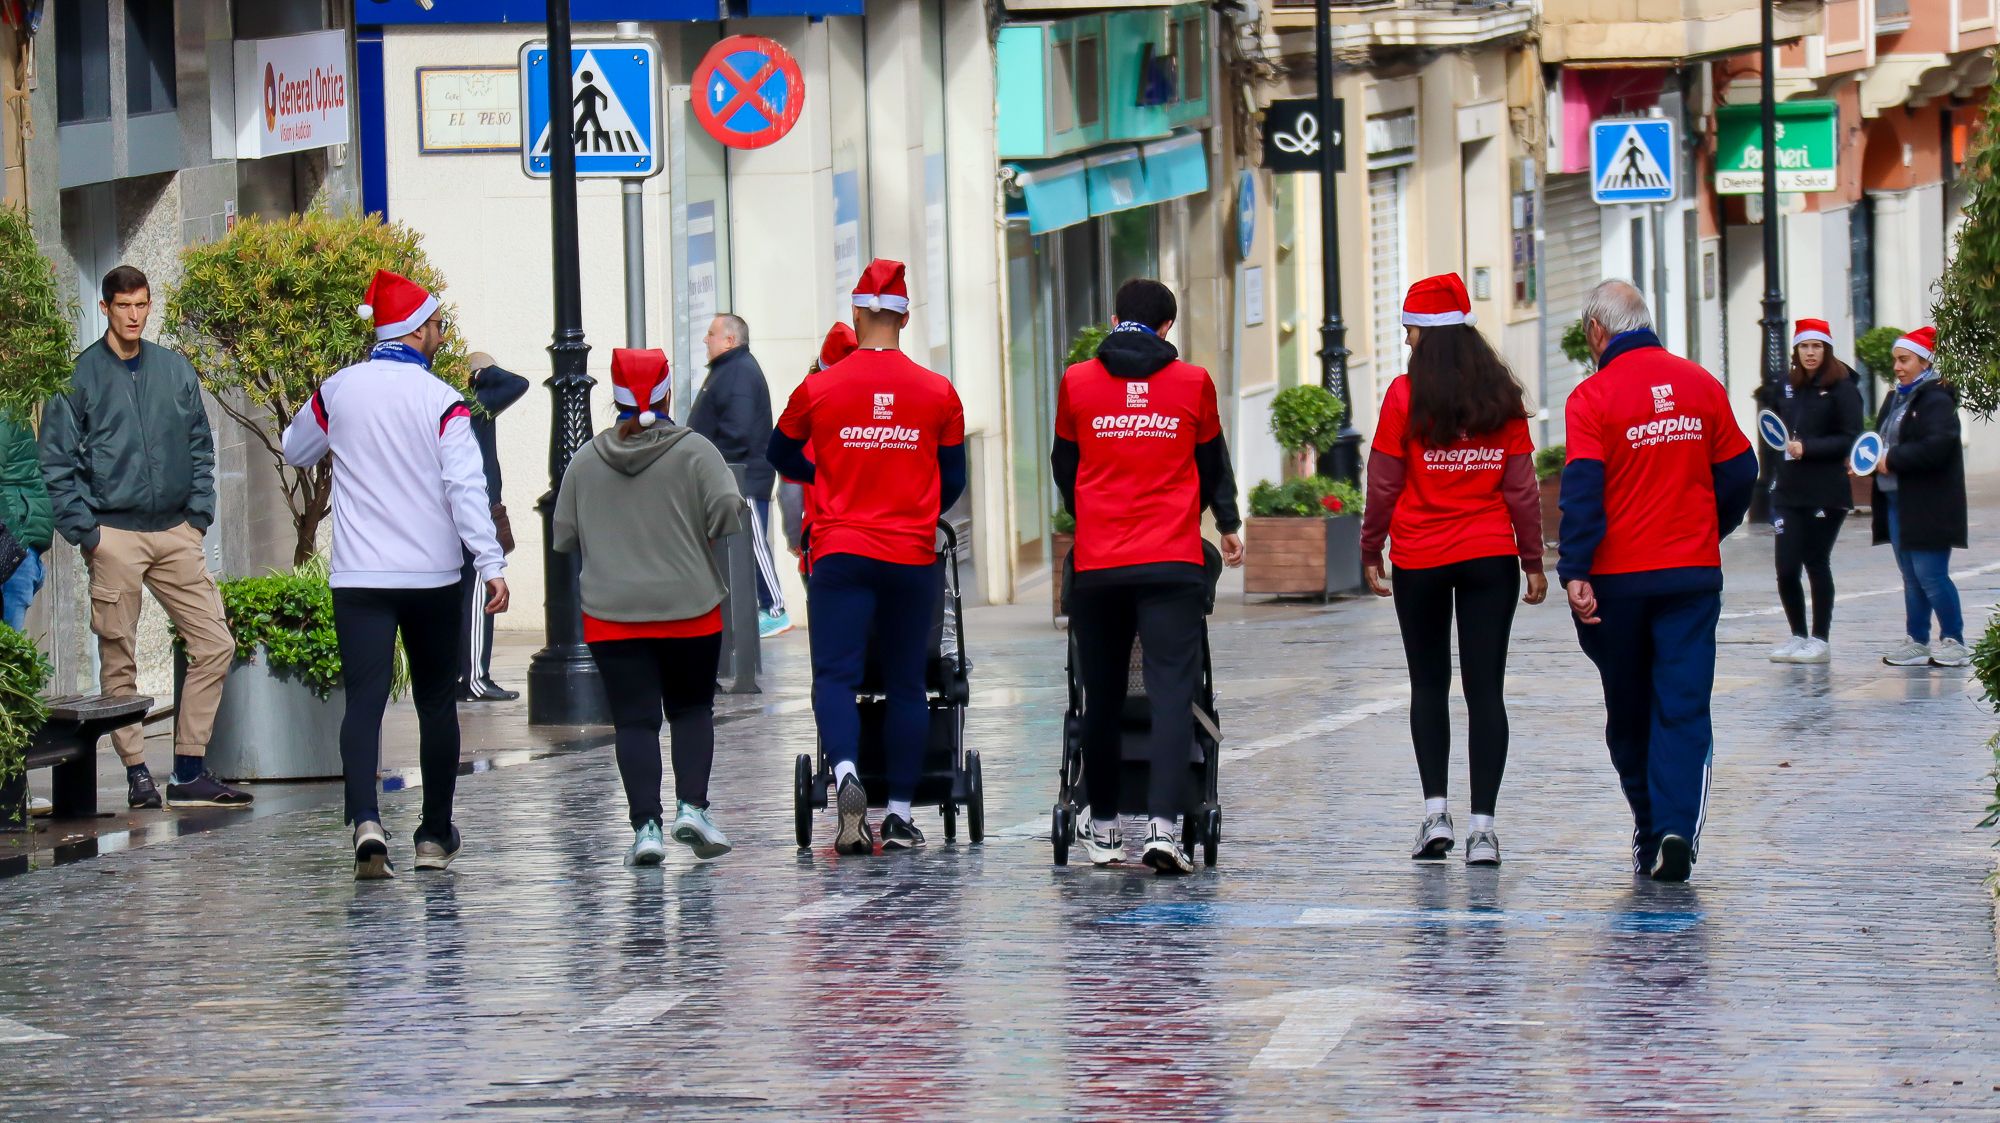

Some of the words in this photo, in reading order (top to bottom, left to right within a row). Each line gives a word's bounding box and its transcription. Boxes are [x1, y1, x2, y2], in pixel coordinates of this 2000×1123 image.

[278, 72, 314, 116] General
[315, 63, 344, 121] Optica
[448, 112, 466, 127] EL
[477, 111, 512, 126] PESO
[1781, 178, 1788, 188] y
[1793, 174, 1828, 187] Salud
[1091, 412, 1180, 431] enerplus
[1626, 415, 1703, 441] enerplus
[839, 425, 920, 443] enerplus
[1135, 429, 1177, 439] positiva
[1666, 431, 1703, 443] positiva
[880, 440, 918, 451] positiva
[1423, 446, 1505, 465] enerplus
[1464, 462, 1502, 472] positiva
